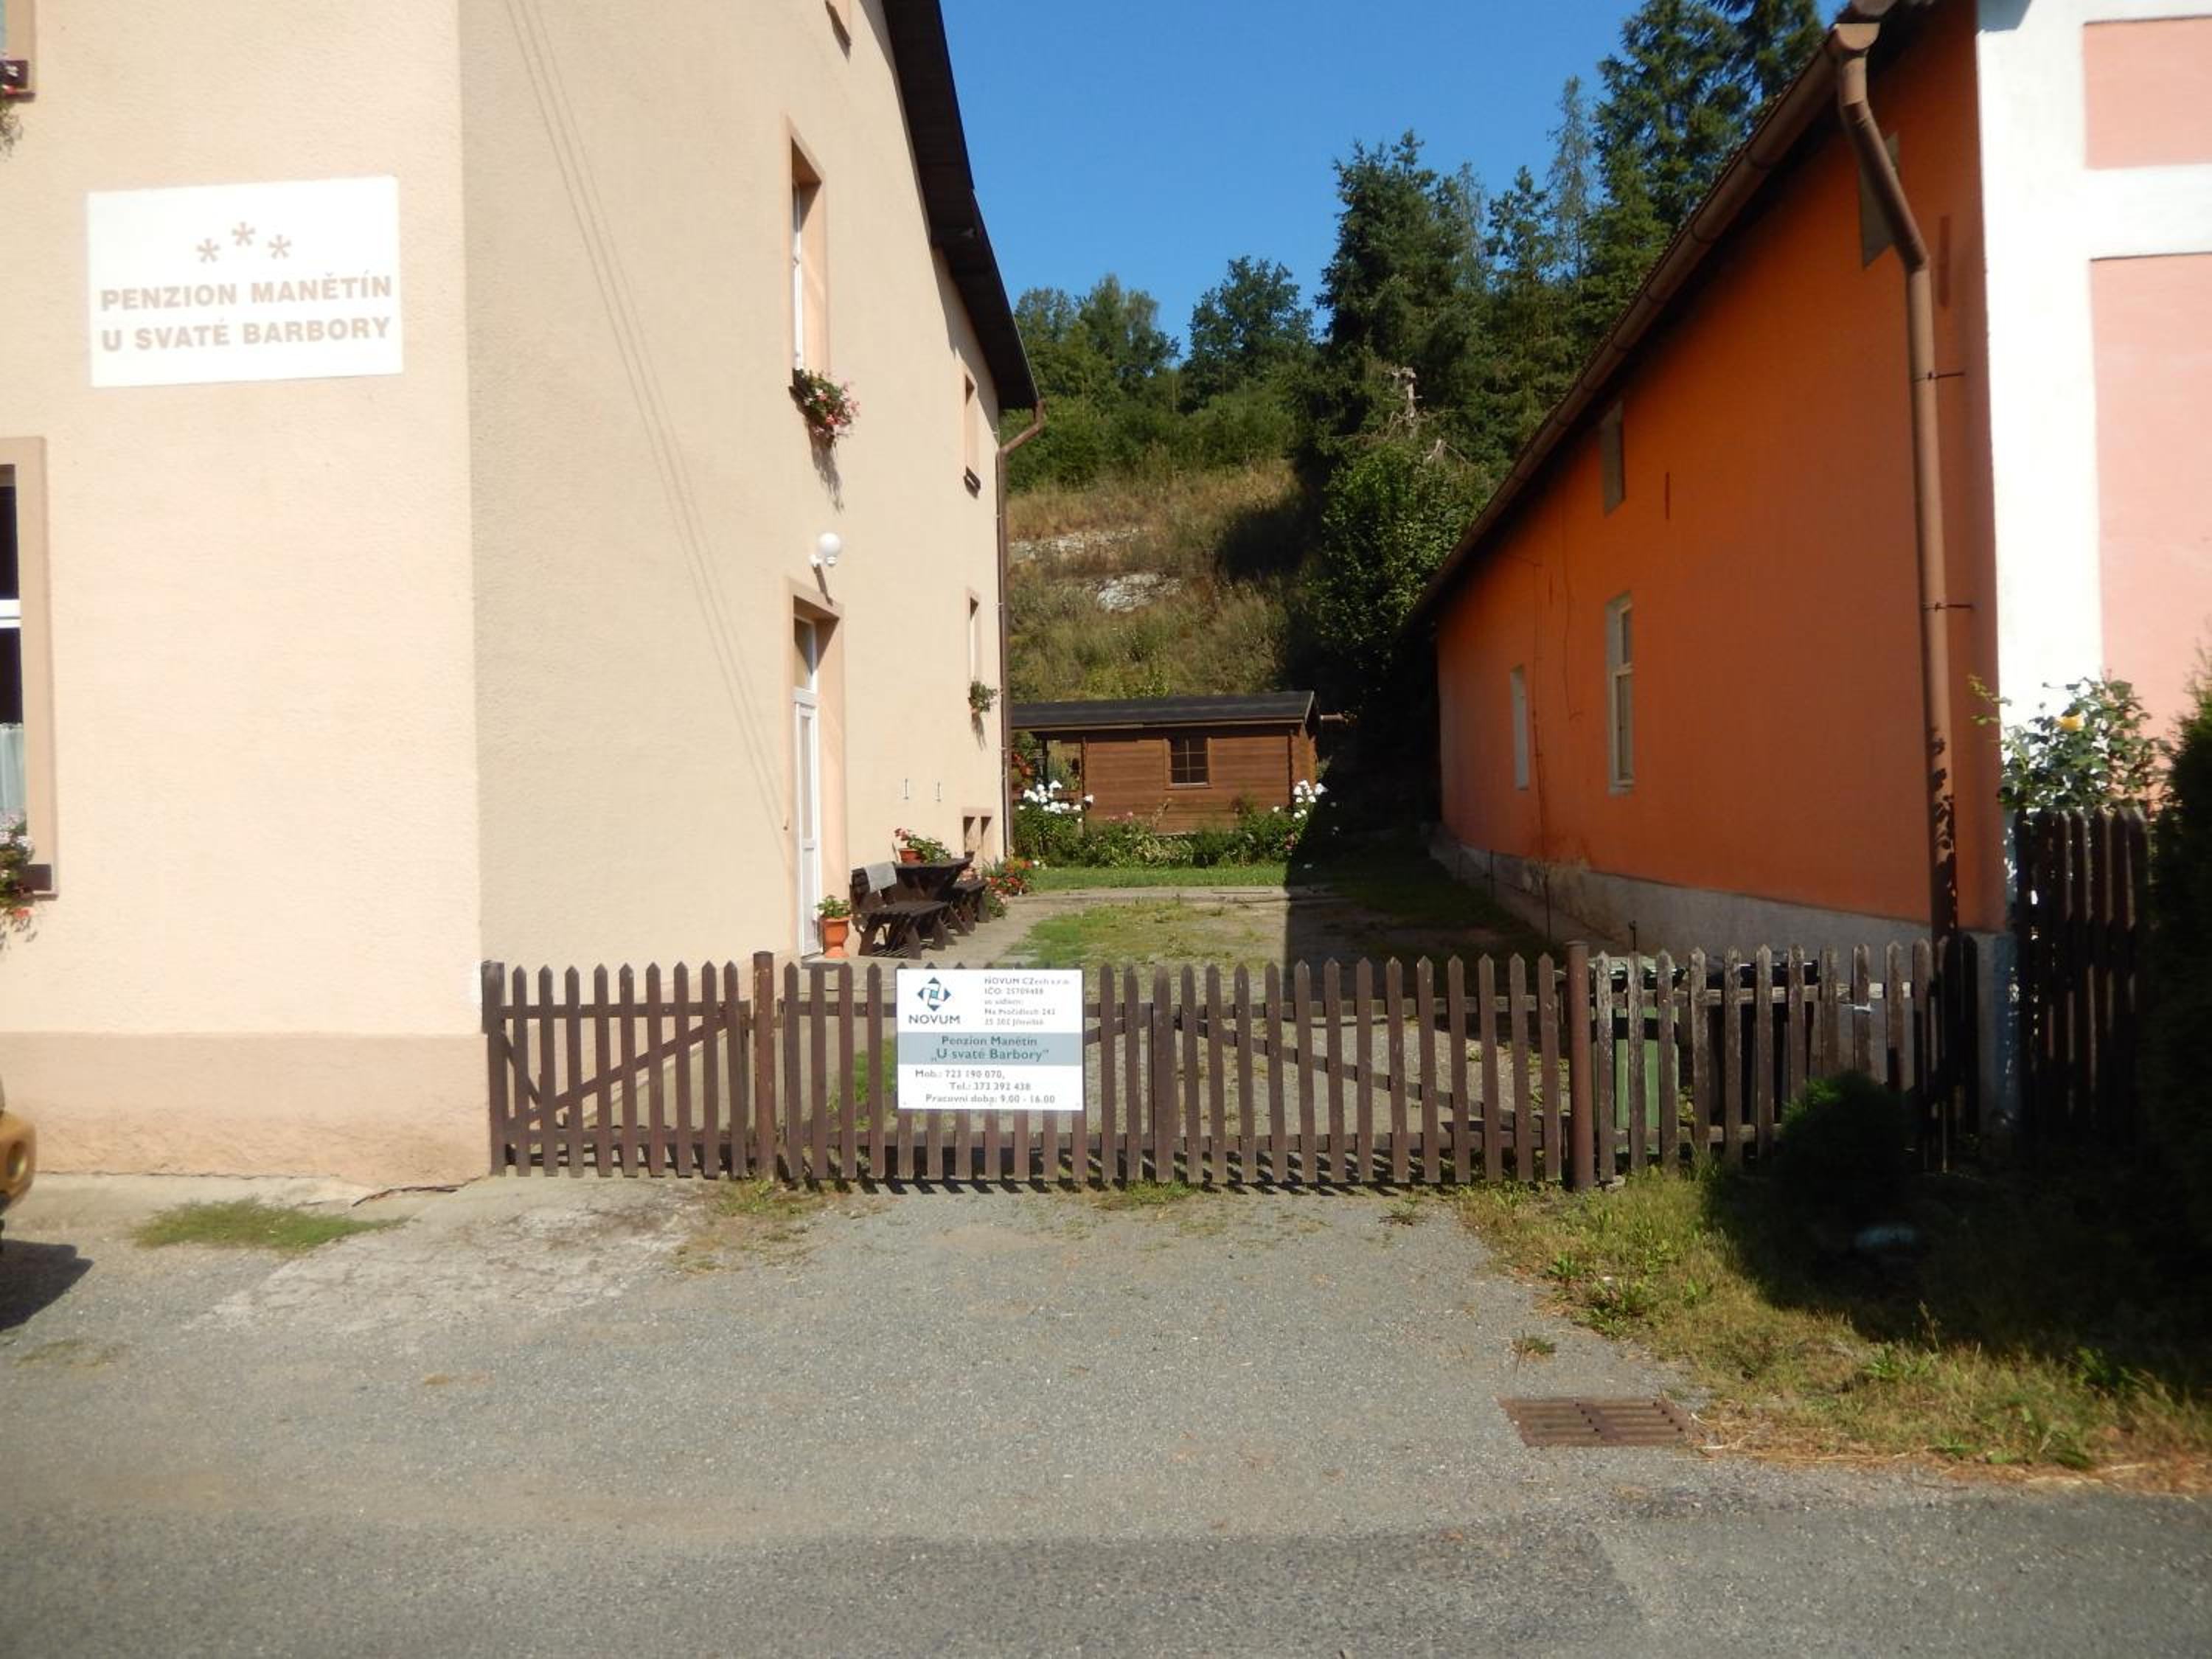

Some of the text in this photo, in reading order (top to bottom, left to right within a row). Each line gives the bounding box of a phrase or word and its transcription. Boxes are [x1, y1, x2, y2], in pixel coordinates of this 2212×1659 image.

[100, 271, 392, 311] PENZION MANĚTÍN
[102, 316, 392, 352] U SVATÉ BARBORY
[908, 1015, 961, 1025] NOVUM
[942, 1035, 987, 1046] Penzion
